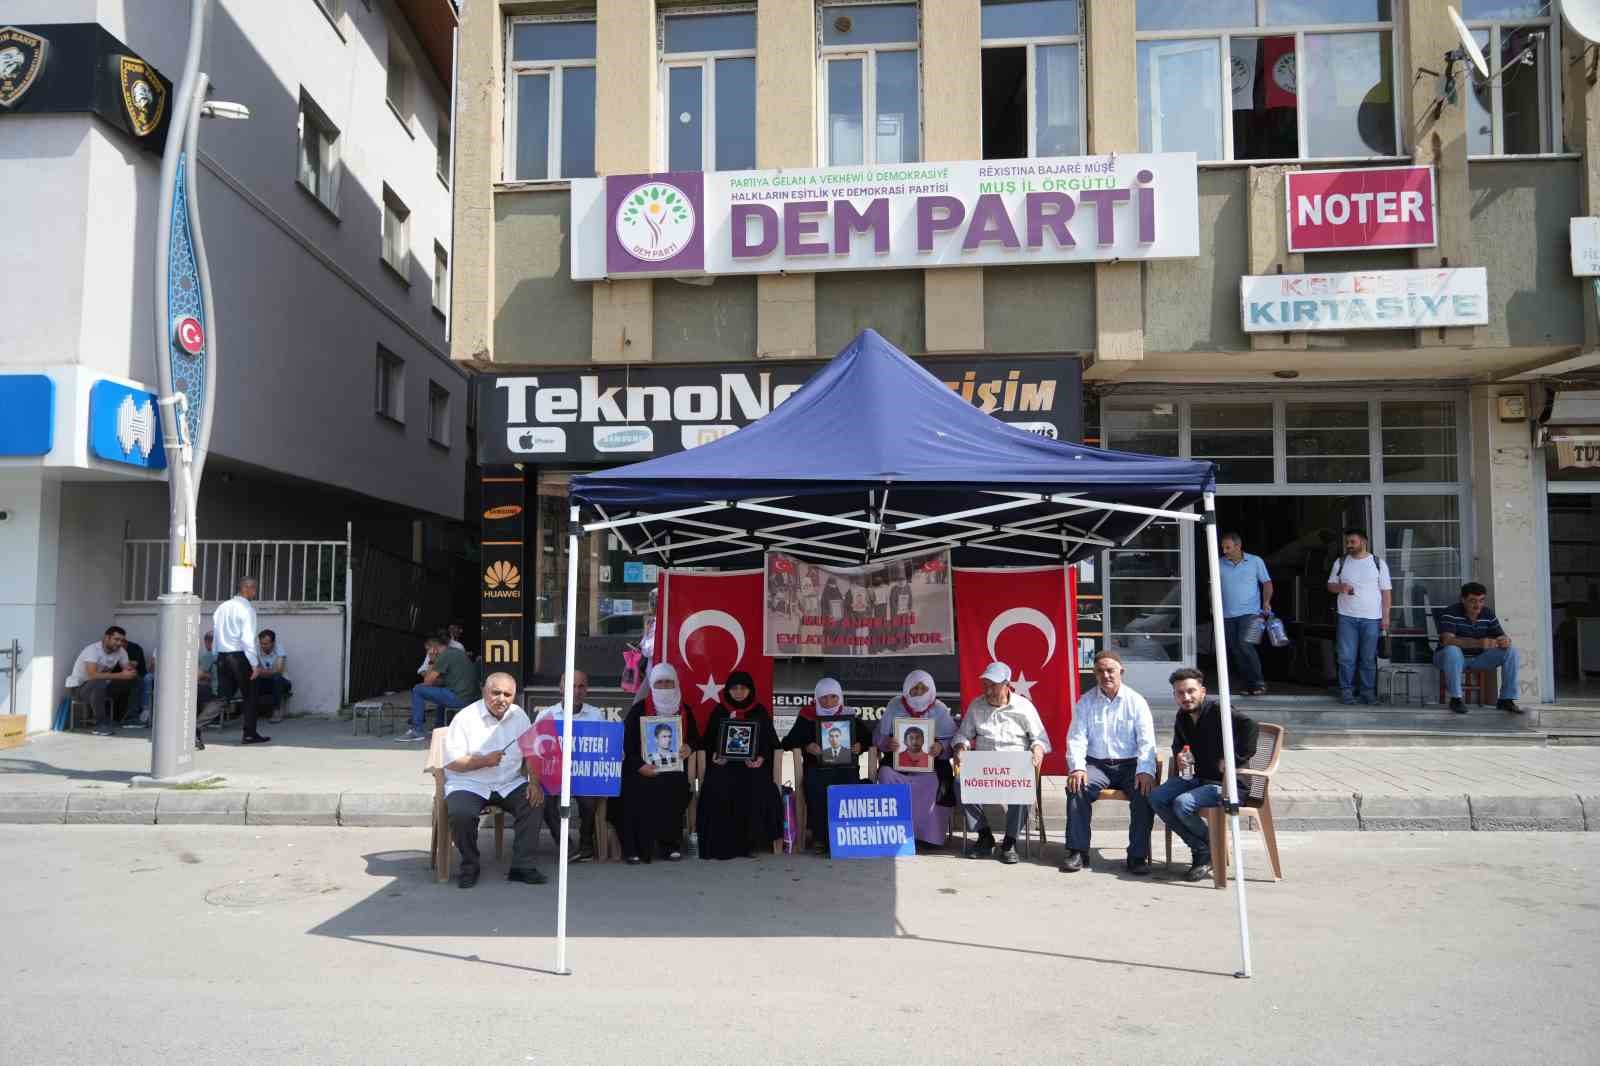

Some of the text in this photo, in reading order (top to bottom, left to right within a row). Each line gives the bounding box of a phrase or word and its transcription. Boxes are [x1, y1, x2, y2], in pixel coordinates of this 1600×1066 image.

[809, 172, 818, 184] A
[979, 178, 1017, 194] MUŞ
[731, 189, 789, 201] HALKLARIN
[832, 187, 845, 198] VE
[731, 169, 1156, 258] DEM PARTİ
[1297, 190, 1426, 226] NOTER
[483, 590, 521, 599] HUAWEI
[578, 735, 603, 753] YETER
[982, 766, 1011, 776] EVLAT
[838, 797, 898, 819] ANNELER
[836, 820, 908, 847] DİRENİYOR
